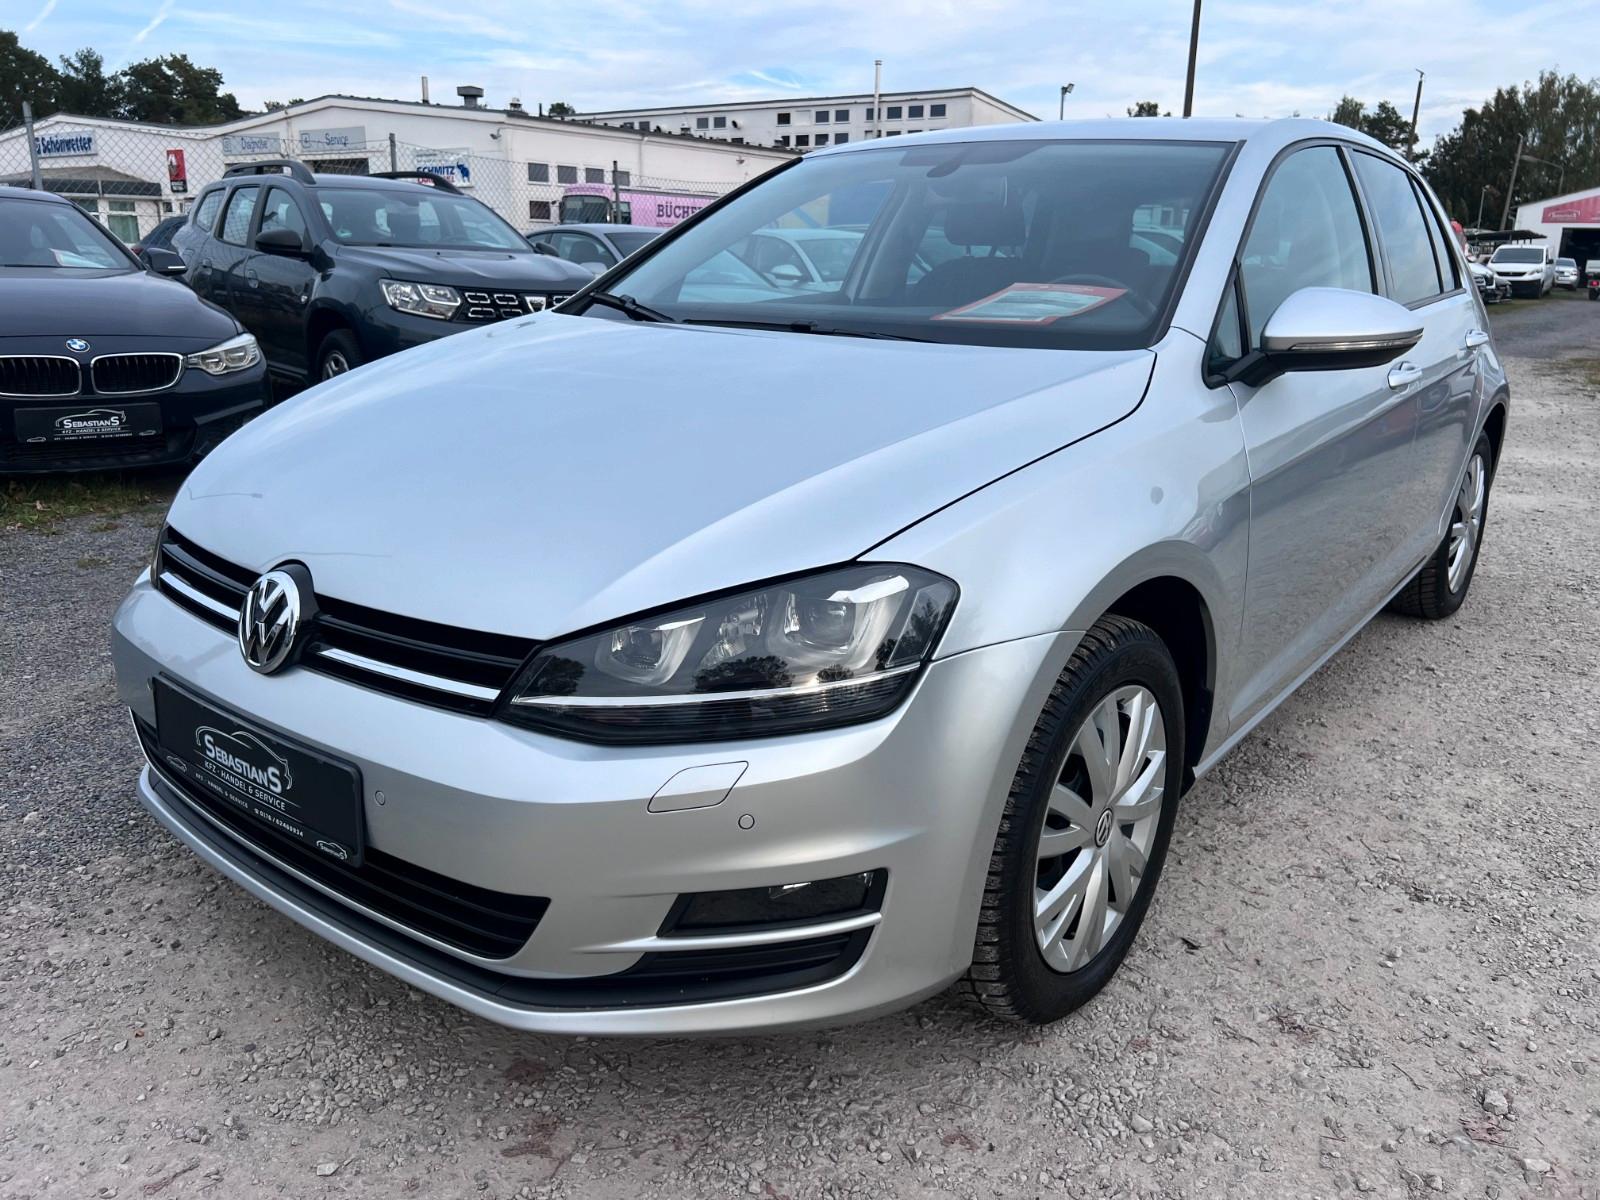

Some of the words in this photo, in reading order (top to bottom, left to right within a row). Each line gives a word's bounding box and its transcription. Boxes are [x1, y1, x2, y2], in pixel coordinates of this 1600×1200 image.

[325, 132, 349, 147] Service
[204, 760, 217, 774] KFZ
[221, 770, 247, 791] HANDEL
[248, 785, 254, 794] &
[255, 789, 286, 812] SERVICE
